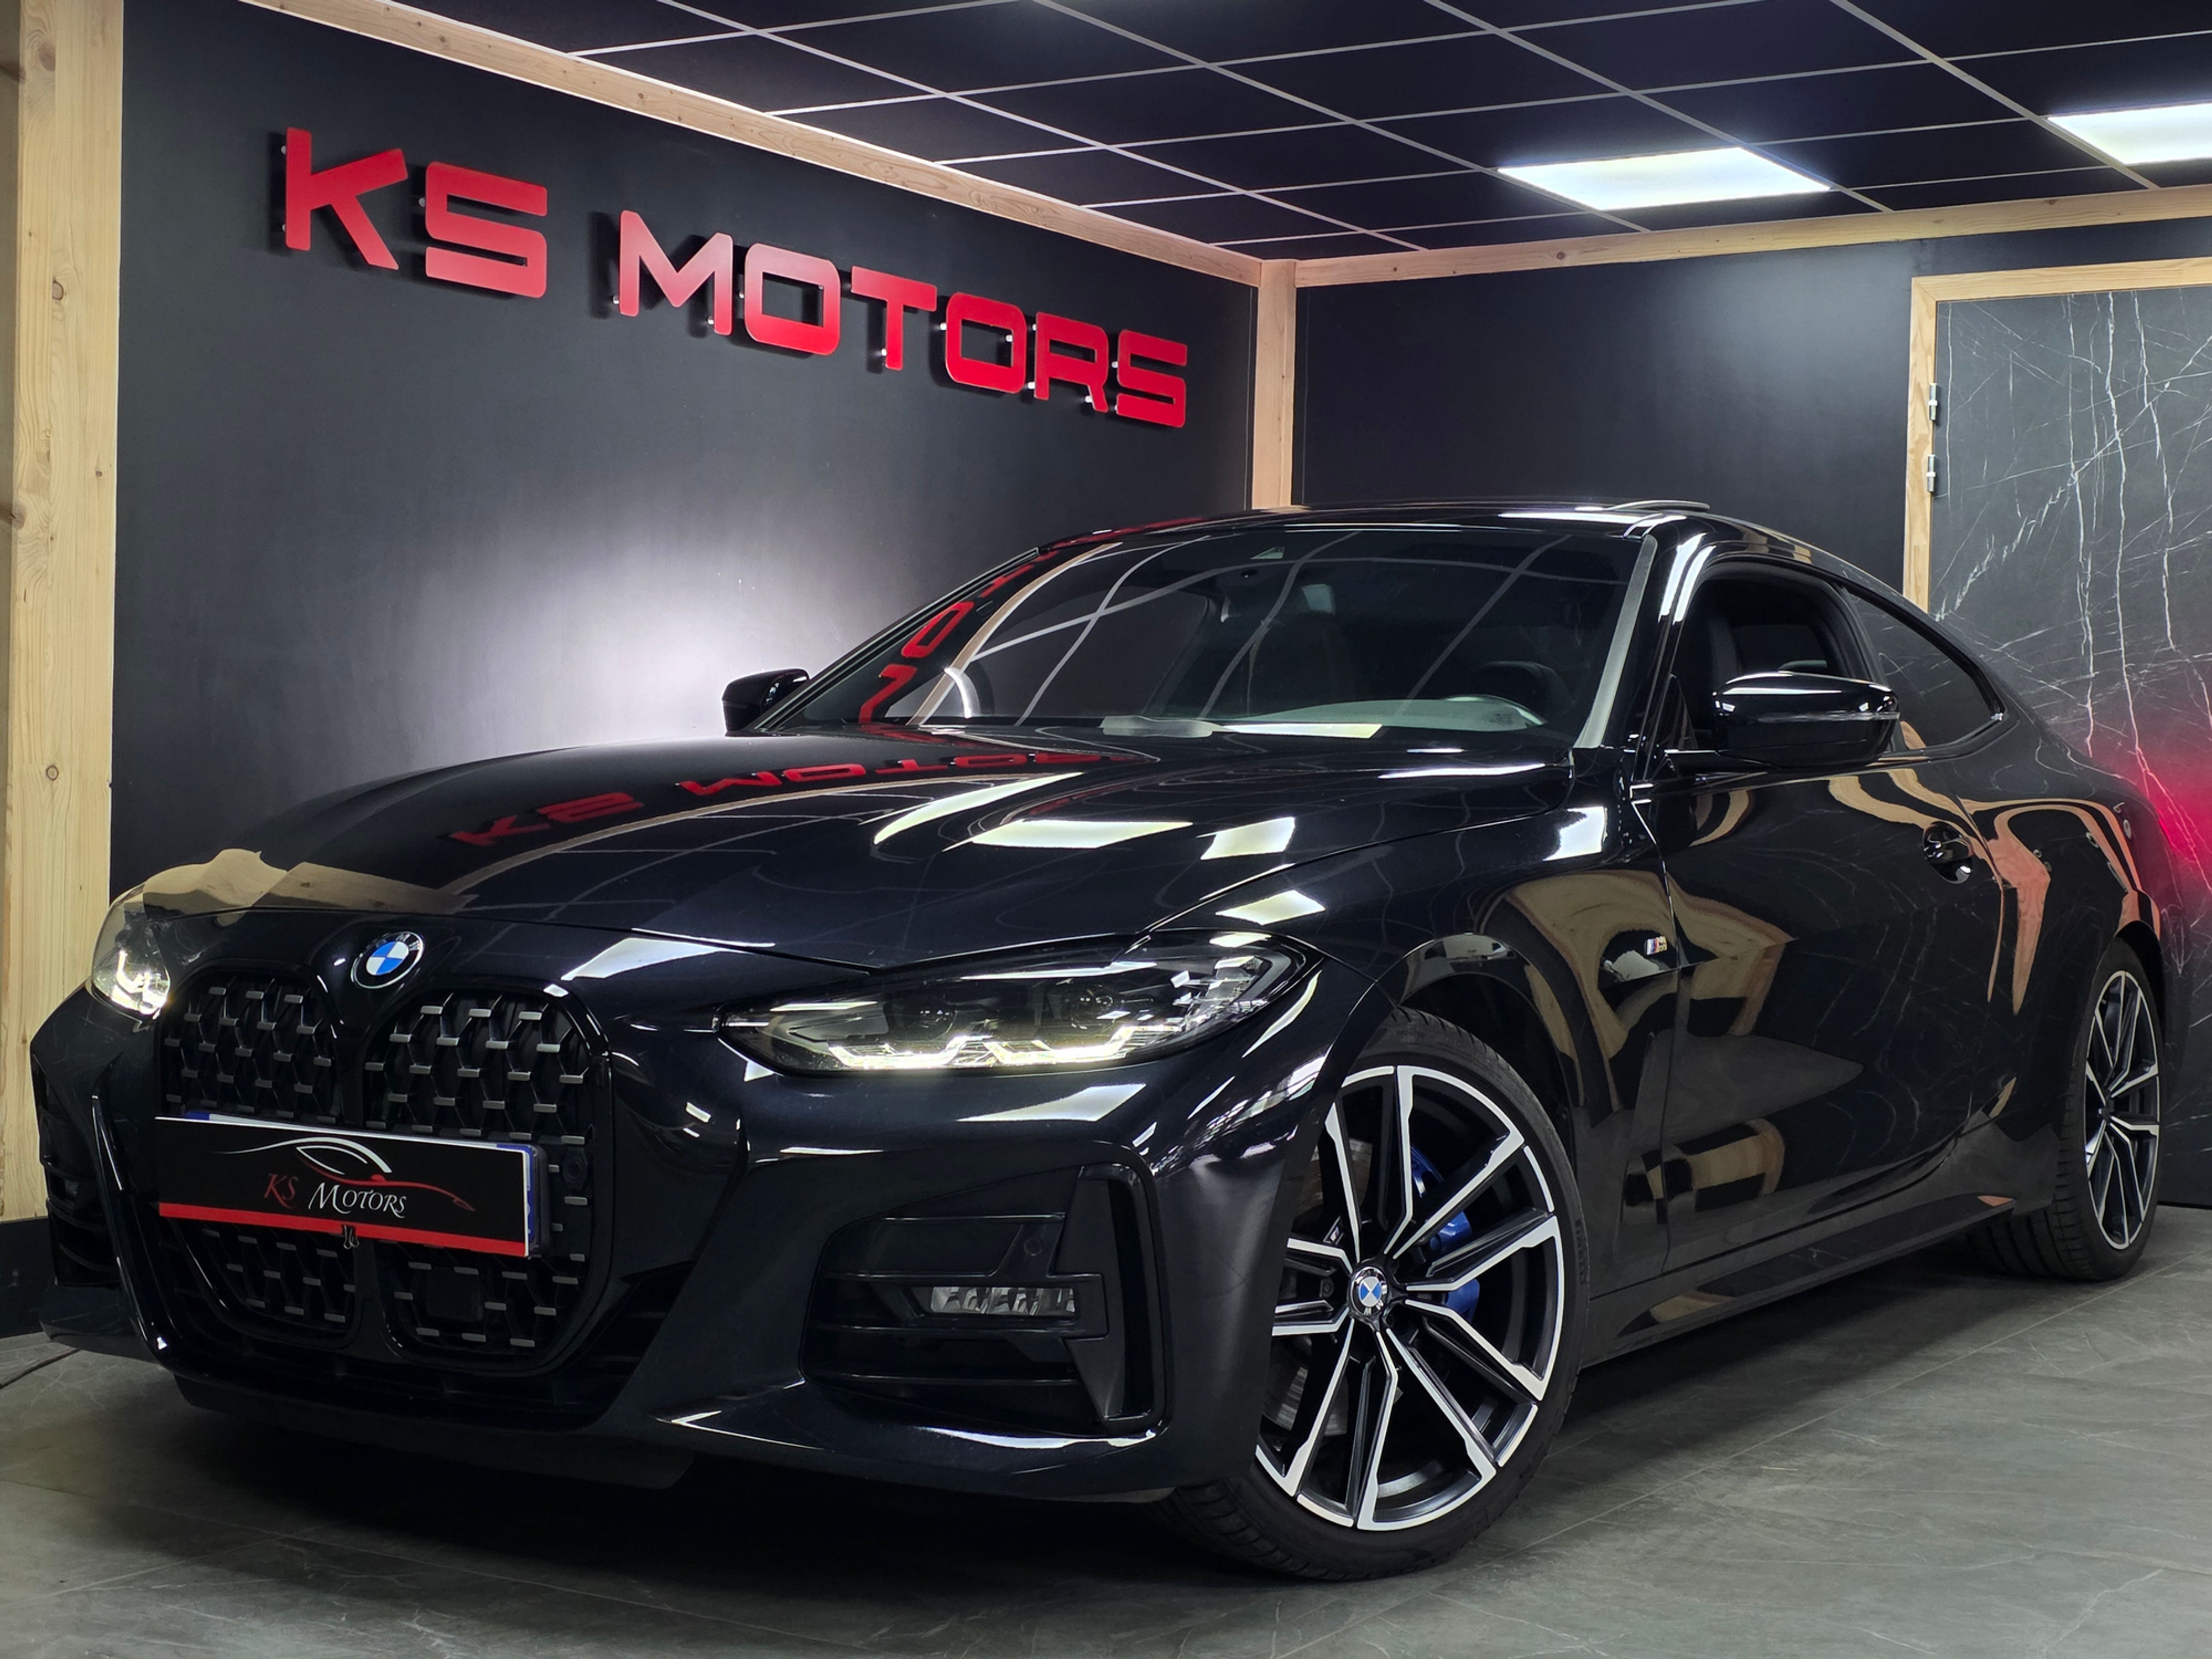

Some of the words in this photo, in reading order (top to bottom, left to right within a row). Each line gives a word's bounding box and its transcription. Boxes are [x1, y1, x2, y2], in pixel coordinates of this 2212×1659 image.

[285, 128, 547, 299] KS
[618, 210, 1188, 428] MOTORS
[264, 1172, 299, 1209] KS
